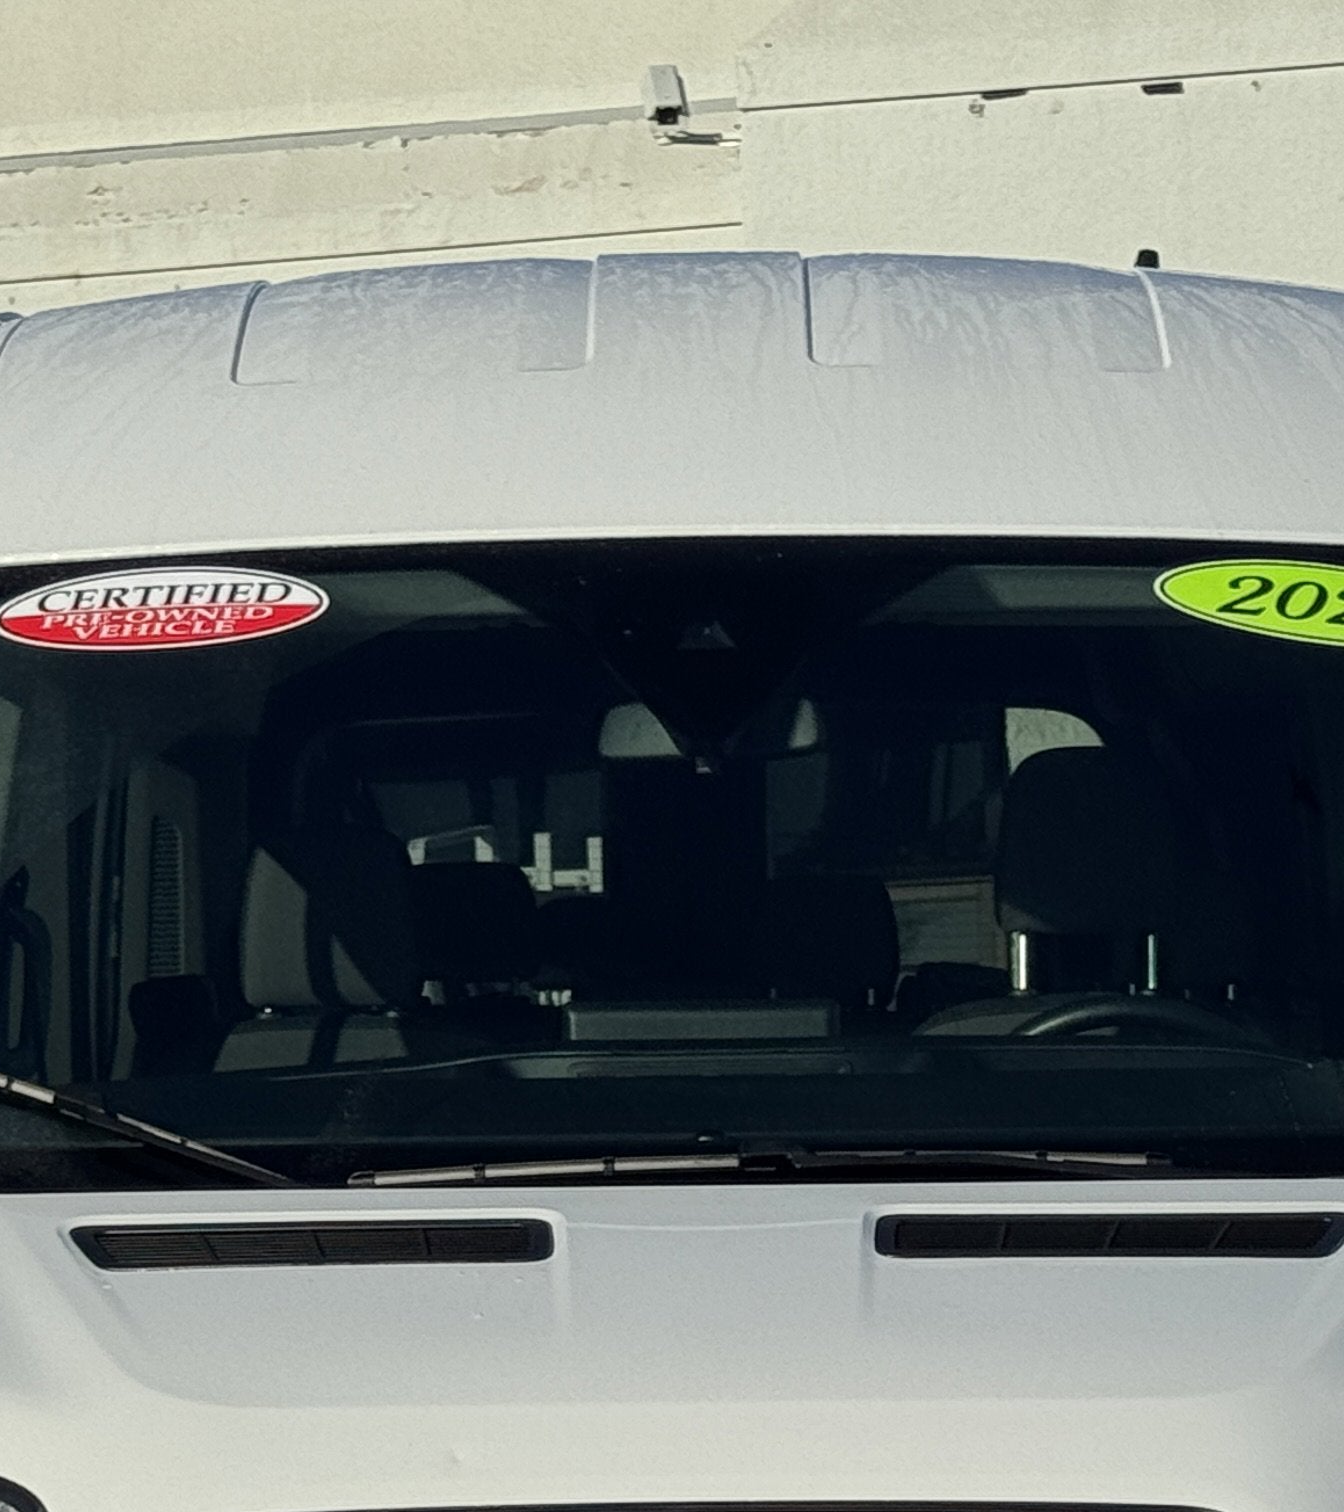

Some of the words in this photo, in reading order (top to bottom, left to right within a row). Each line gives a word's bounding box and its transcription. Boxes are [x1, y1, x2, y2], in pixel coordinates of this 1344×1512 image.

[37, 582, 293, 613] CERTIFIED
[41, 606, 273, 630] PRE-OWNED
[73, 620, 236, 640] VEHICLE
